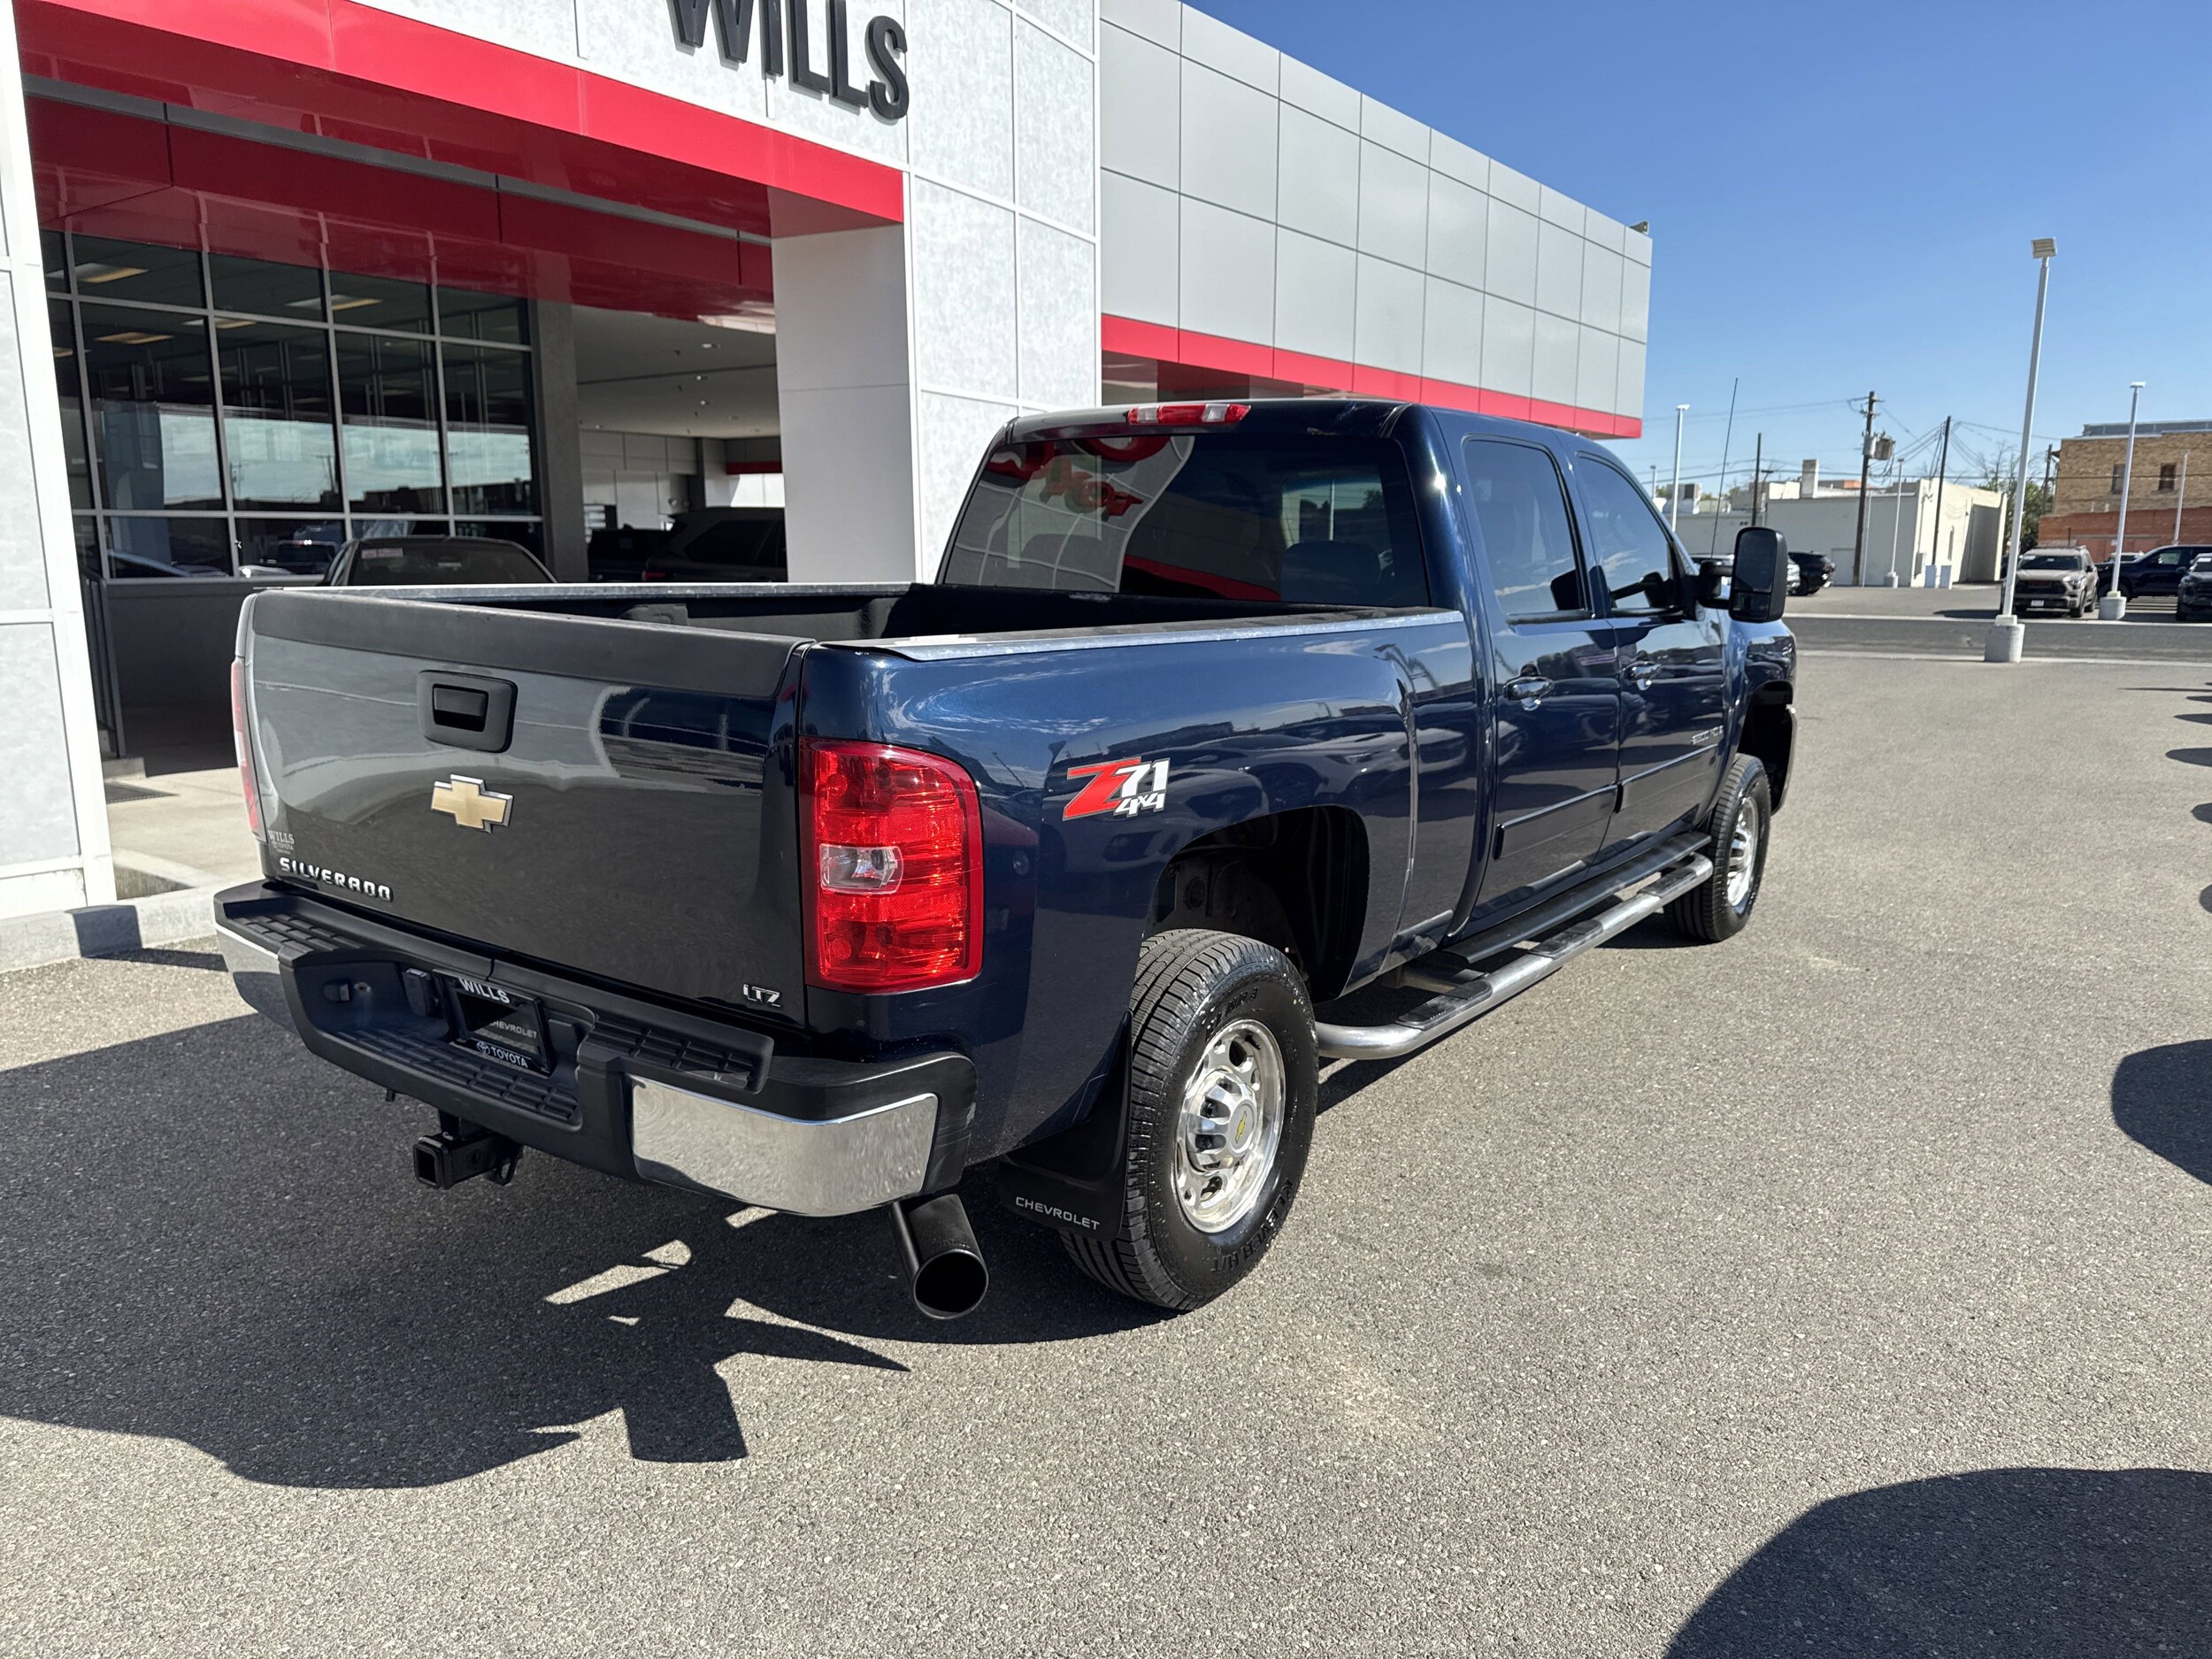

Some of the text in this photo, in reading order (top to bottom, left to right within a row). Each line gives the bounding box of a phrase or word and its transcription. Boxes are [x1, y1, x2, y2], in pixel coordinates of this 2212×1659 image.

[1063, 757, 1170, 821] Z71
[267, 829, 295, 845] WILLS
[280, 856, 393, 901] SILVERADO
[459, 979, 510, 1003] WILLS
[743, 984, 781, 1007] LTZ
[490, 1047, 528, 1068] TOYOTA
[1015, 1196, 1100, 1230] CHEVROLET
